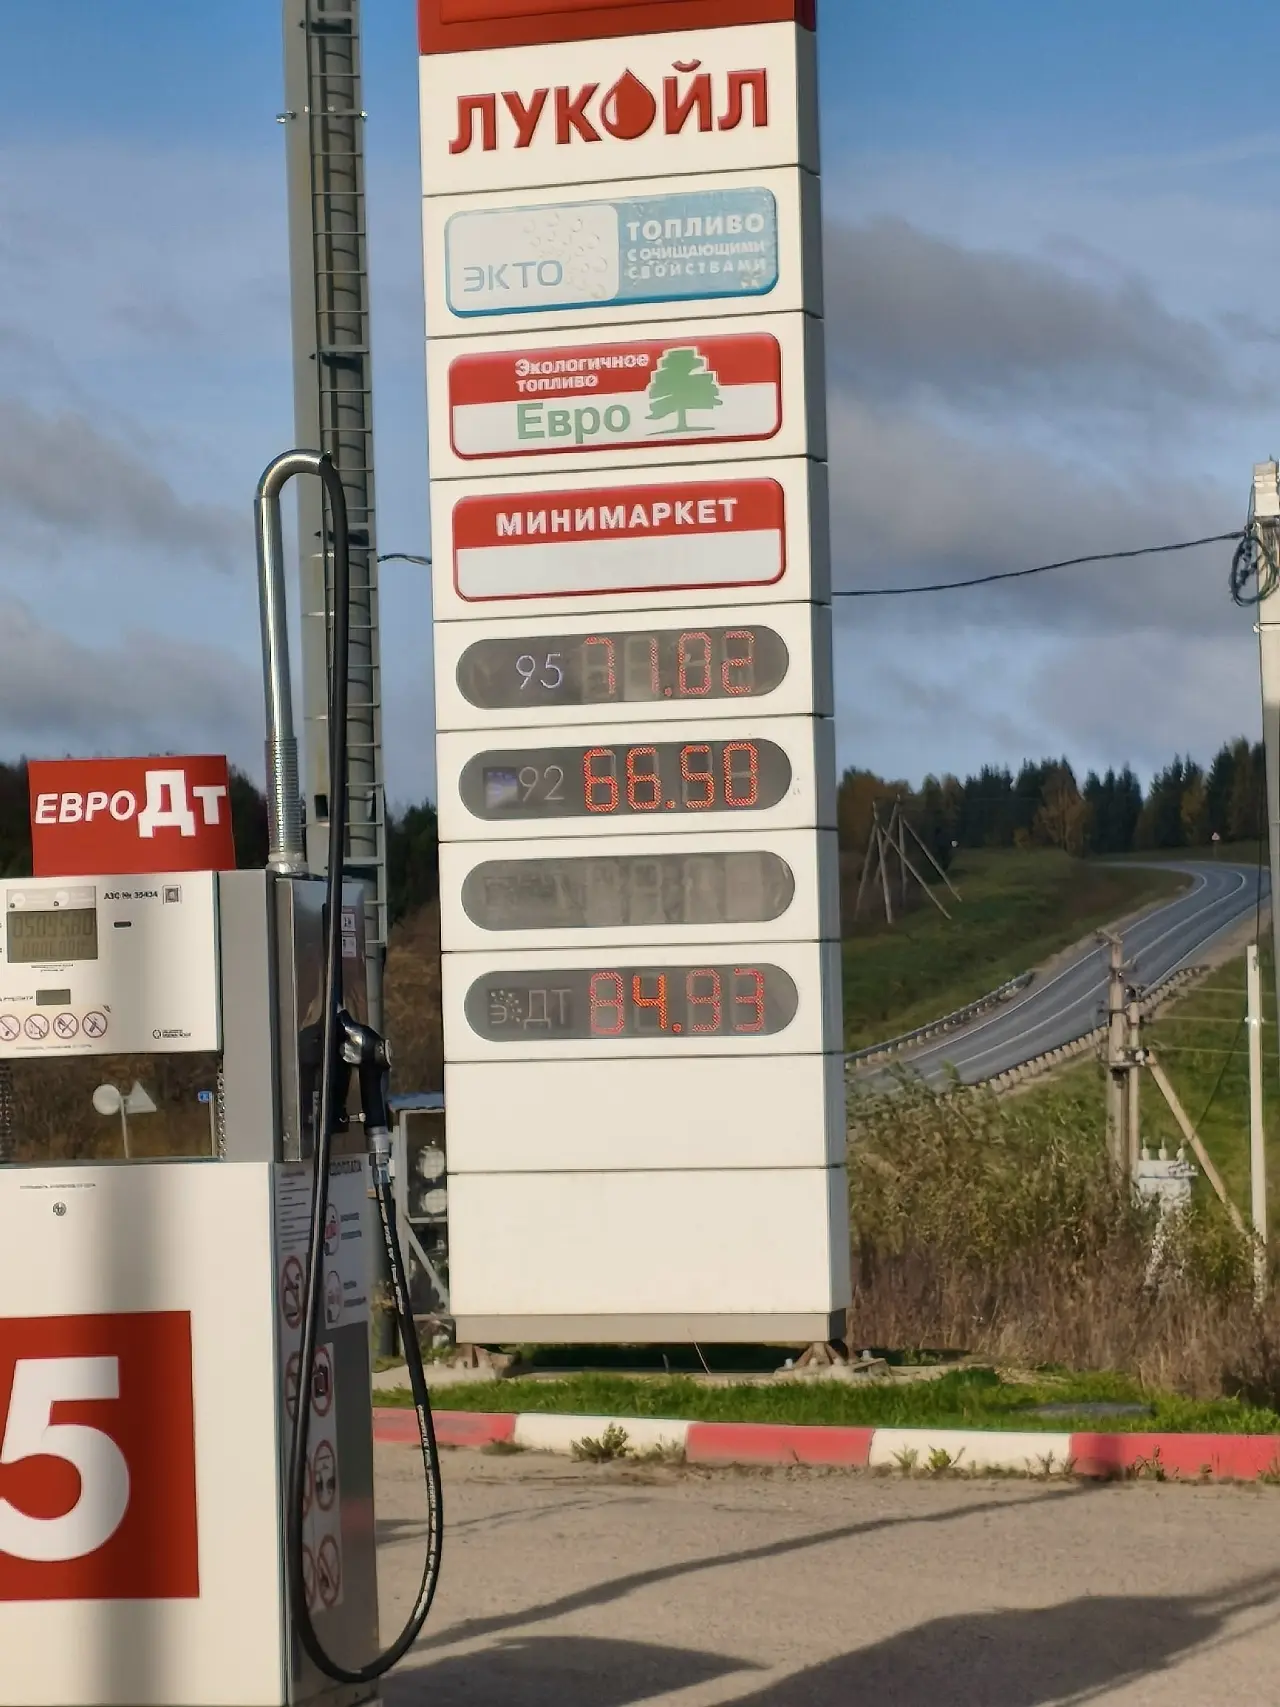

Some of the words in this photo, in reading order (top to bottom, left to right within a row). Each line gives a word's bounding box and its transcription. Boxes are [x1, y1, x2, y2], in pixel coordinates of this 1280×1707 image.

[449, 59, 769, 155] ЛУКОЙЛ
[626, 213, 765, 241] ТОПЛИВО
[463, 259, 563, 292] ЭКТО
[515, 353, 650, 377] Экологичное
[515, 374, 598, 393] топливо
[516, 402, 631, 444] Евро
[496, 497, 738, 537] МИНИМАРКЕТ
[515, 653, 564, 690] 95
[584, 630, 755, 697] 71.02
[518, 764, 565, 802] 92
[583, 741, 758, 812] 66.50
[523, 988, 572, 1031] ДТ
[0, 1355, 131, 1562] 5
